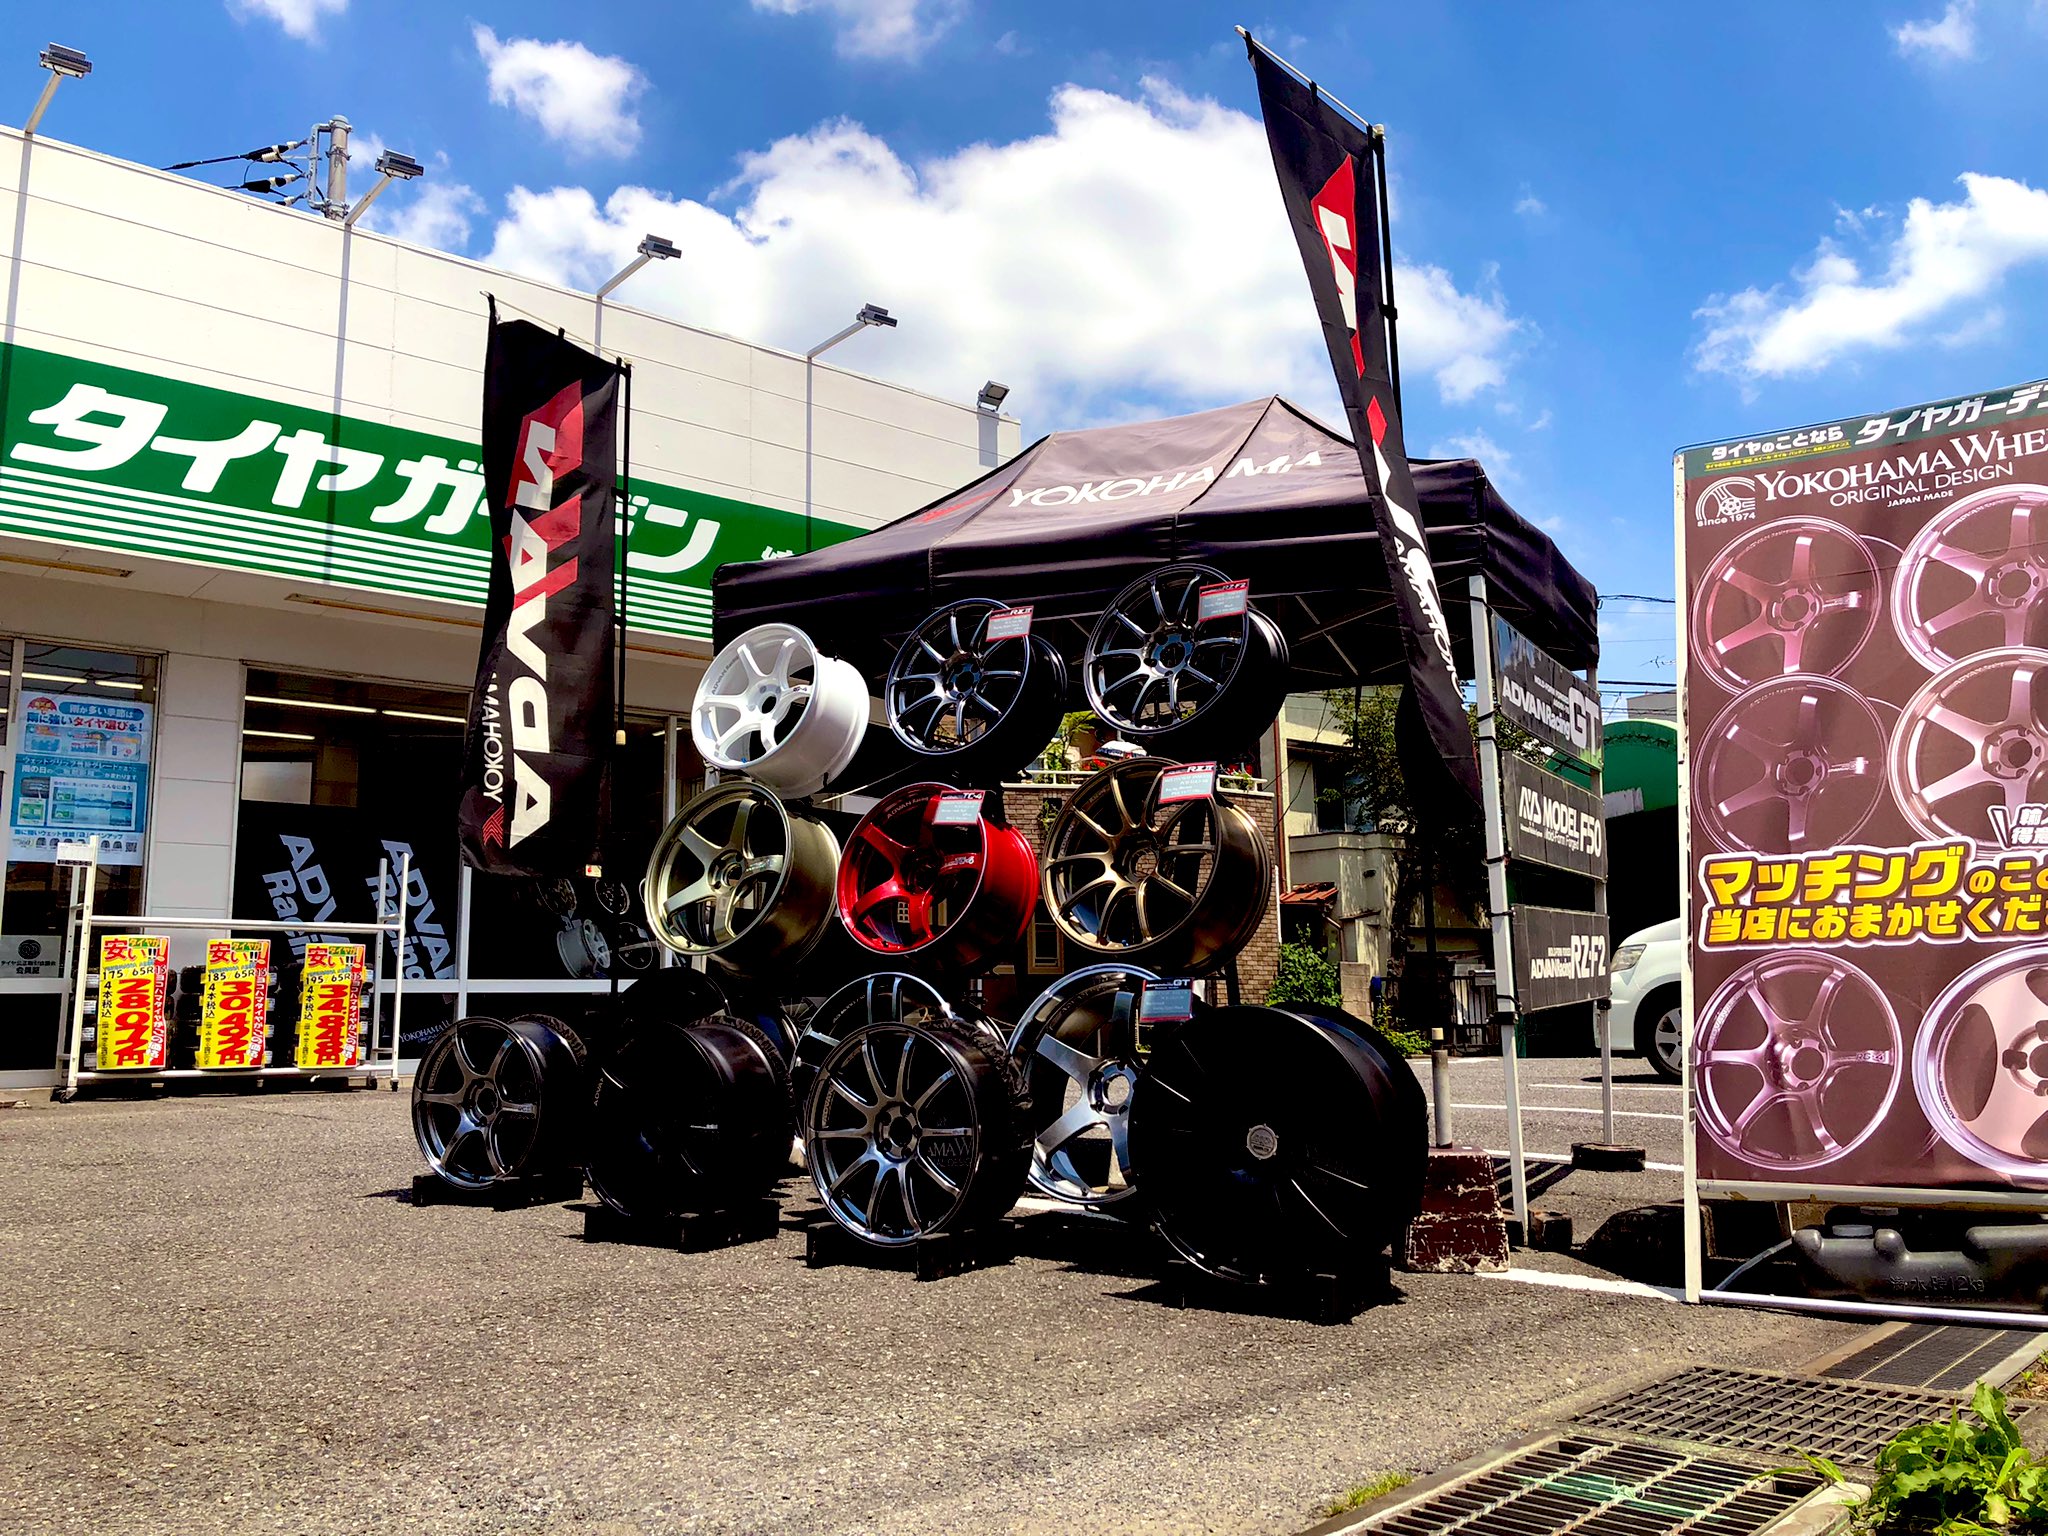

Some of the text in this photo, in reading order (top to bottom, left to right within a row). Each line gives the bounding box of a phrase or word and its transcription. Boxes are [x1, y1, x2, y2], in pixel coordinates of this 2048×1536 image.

[1711, 425, 1844, 461] タイヤのことなら
[1755, 429, 2048, 502] YOKOHAMA WHE
[1830, 461, 2014, 507] ORIGINAL DESIGN
[1887, 489, 1954, 508] JAPAN MADE
[1697, 511, 1756, 528] since 1974
[1569, 686, 1600, 756] GT
[1543, 795, 1579, 838] MODEL
[1580, 812, 1602, 858] F50
[1708, 893, 2048, 943] 当店におまかせくだ
[103, 969, 124, 980] 175
[207, 972, 227, 982] 185
[305, 975, 324, 985] 195
